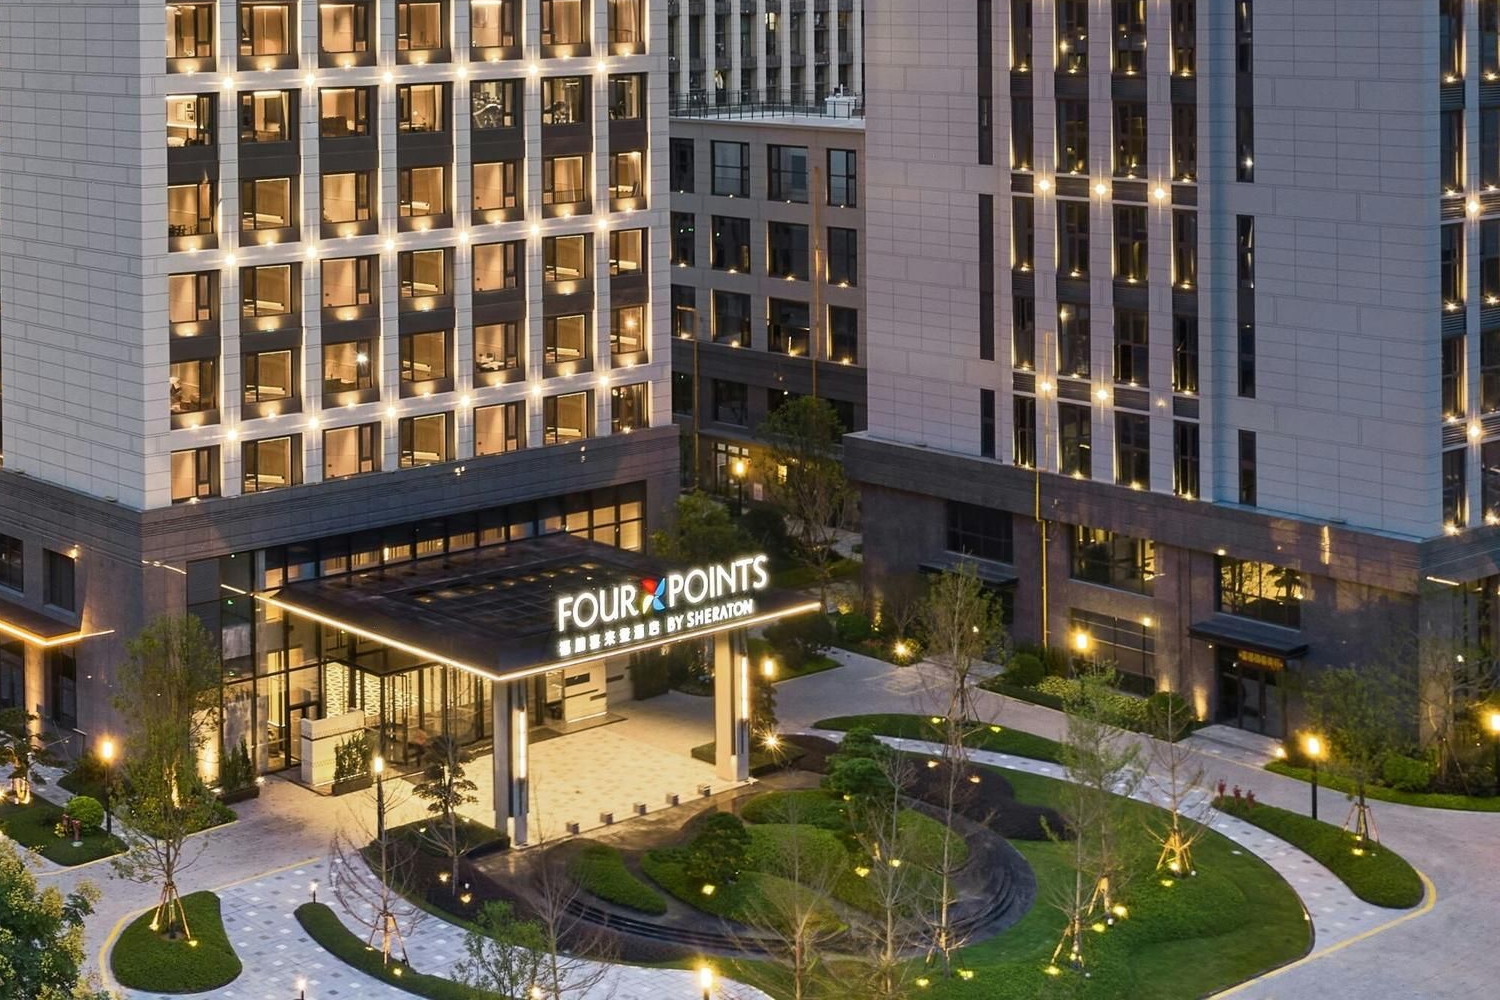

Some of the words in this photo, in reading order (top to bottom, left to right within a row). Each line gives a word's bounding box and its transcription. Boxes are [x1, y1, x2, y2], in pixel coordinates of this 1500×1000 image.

[557, 584, 639, 632] FOUR
[668, 554, 769, 608] POINTS
[666, 614, 684, 633] BY
[686, 598, 754, 628] SHERATON
